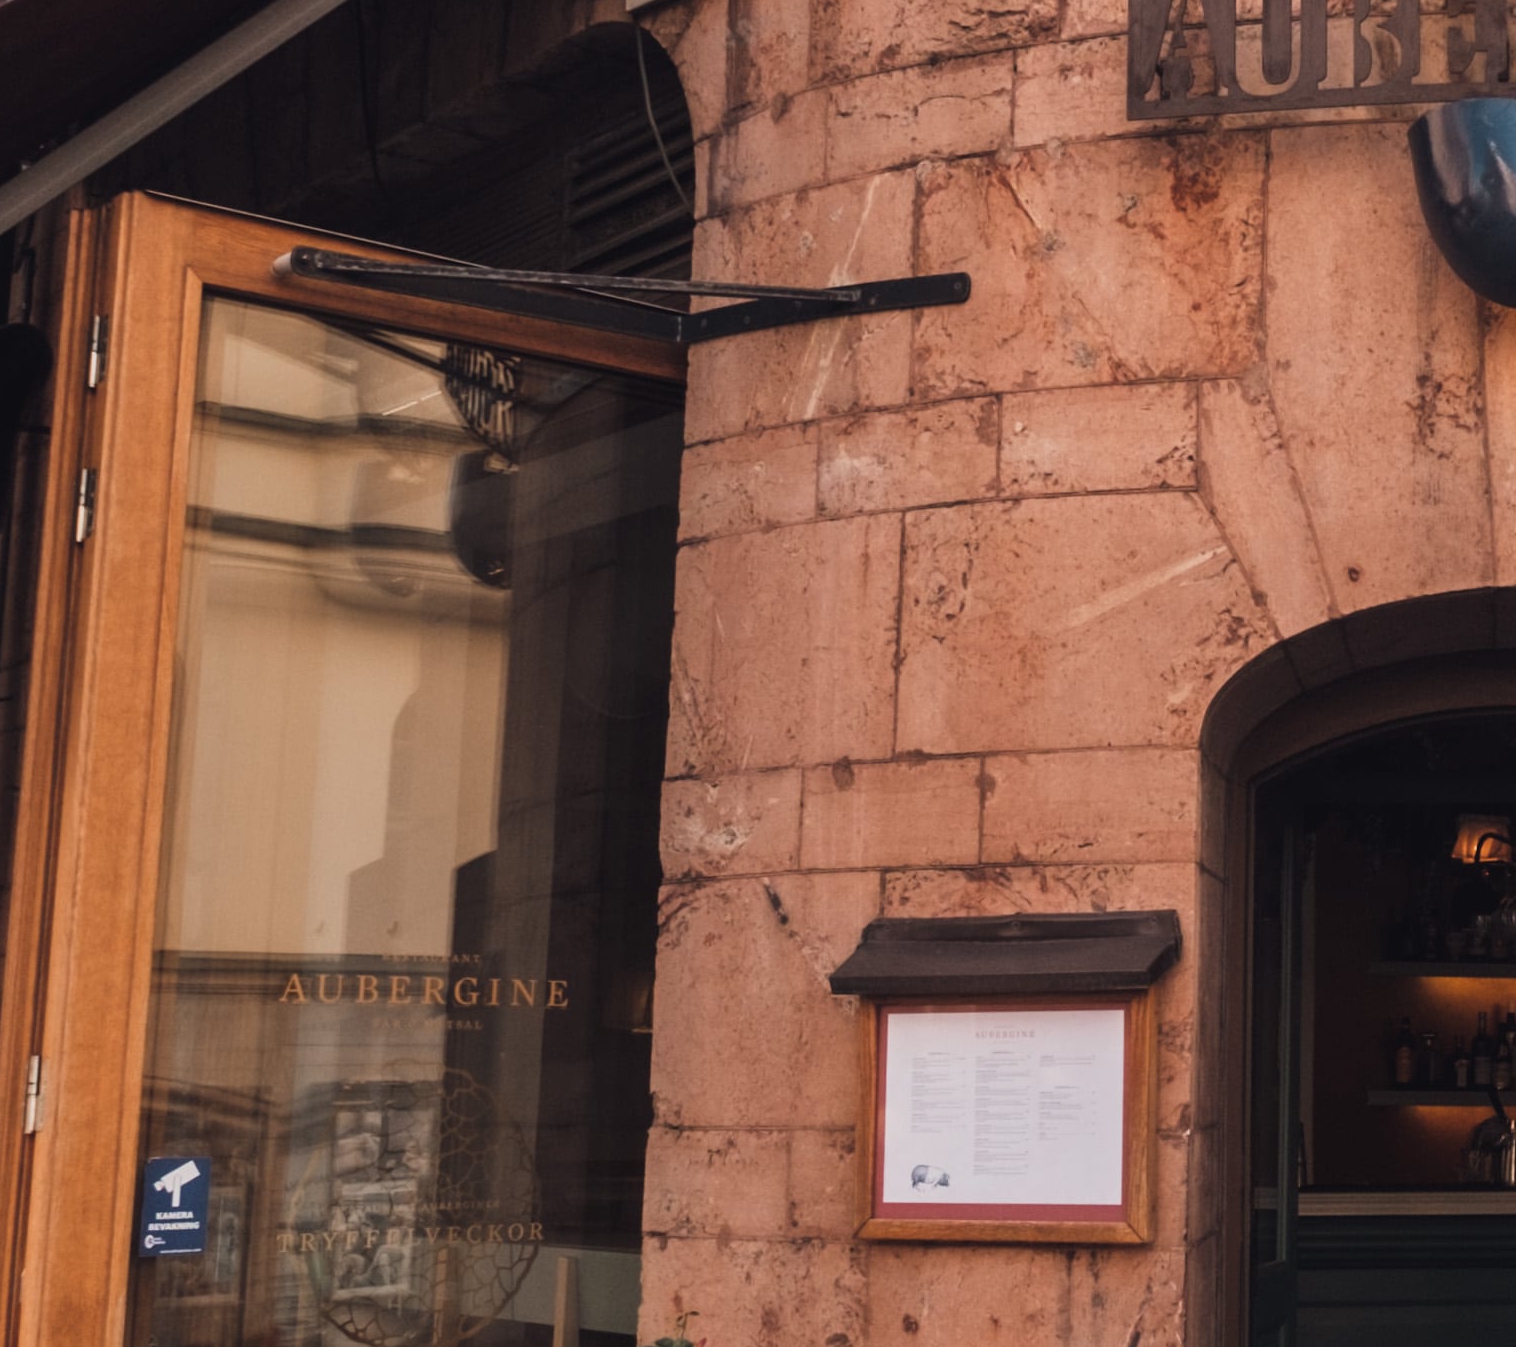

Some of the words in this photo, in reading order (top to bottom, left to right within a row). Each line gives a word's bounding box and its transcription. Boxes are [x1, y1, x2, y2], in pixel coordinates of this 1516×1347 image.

[279, 973, 569, 1007] AUBERGINE
[155, 1211, 194, 1220] KAMERA
[148, 1221, 201, 1231] BEVAKNING
[276, 1223, 545, 1252] TRYFFELVECKOR
